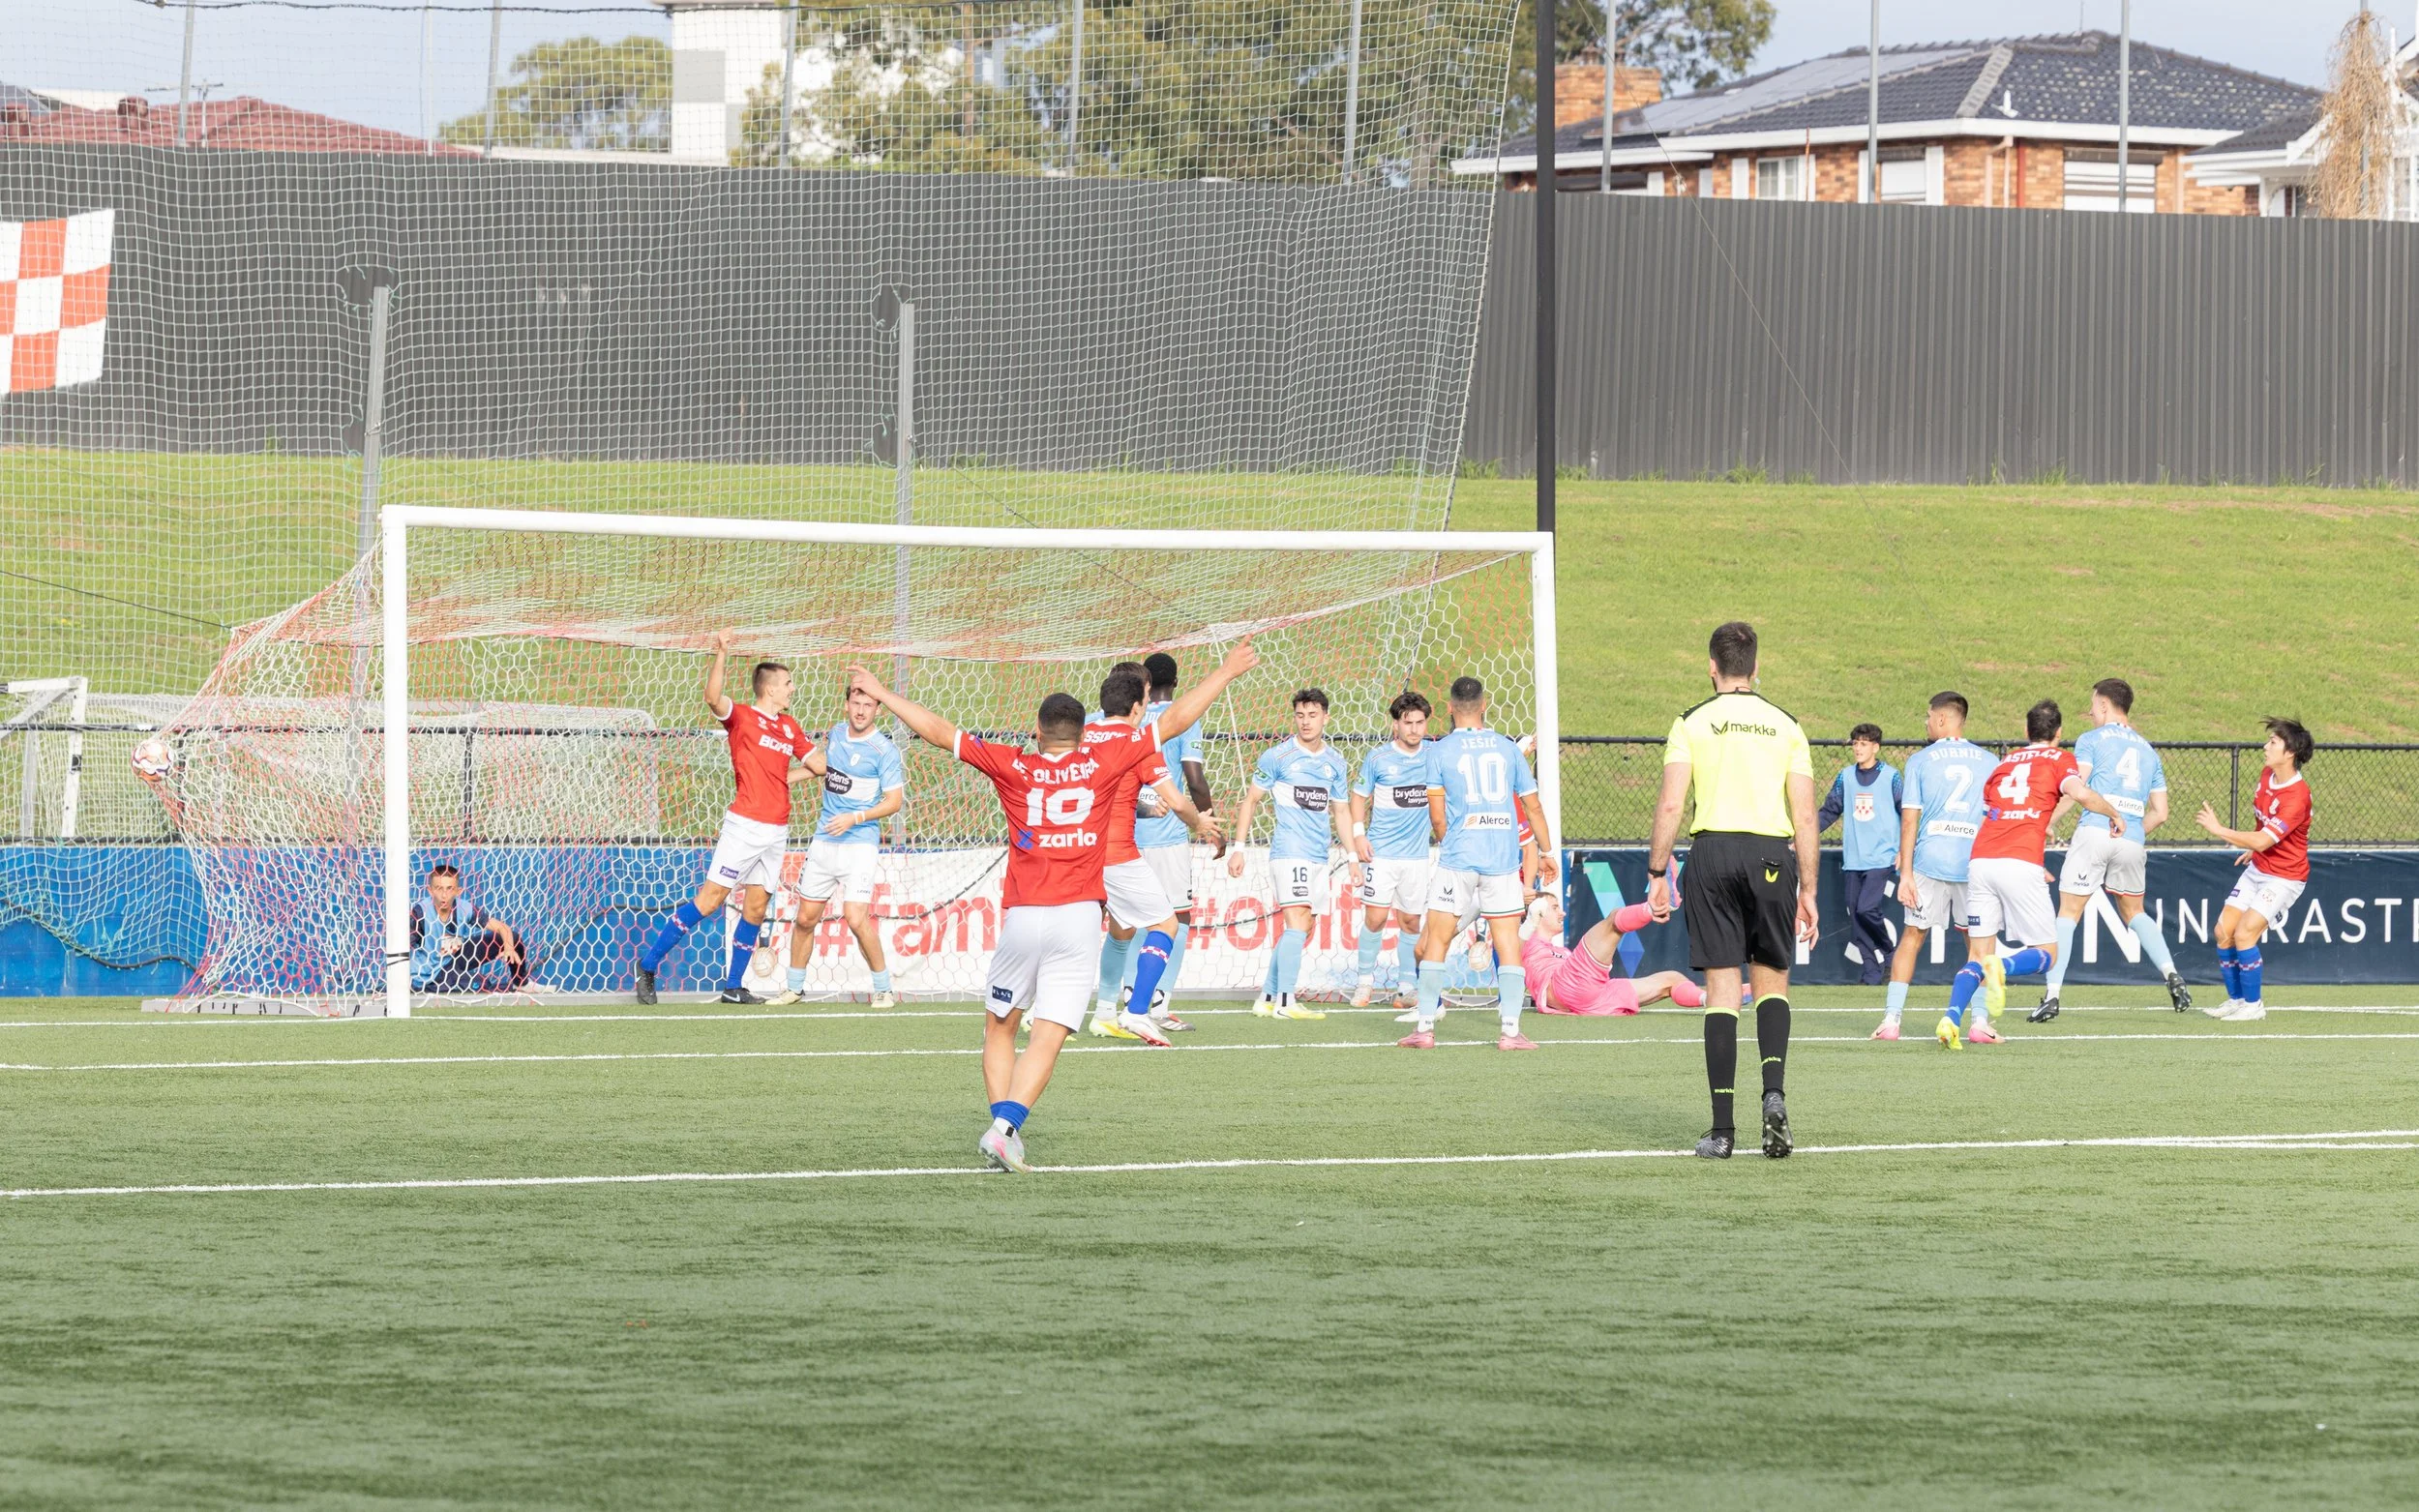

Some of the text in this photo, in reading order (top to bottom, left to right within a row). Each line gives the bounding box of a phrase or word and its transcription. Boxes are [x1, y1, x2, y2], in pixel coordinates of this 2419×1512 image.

[1730, 723, 1777, 737] markka
[825, 772, 851, 786] rydens
[1032, 757, 1100, 786] OLIVEIRA
[1456, 752, 1508, 806] 10
[2115, 746, 2140, 791] 4
[1296, 788, 1328, 802] brydens
[1944, 764, 1974, 814] 2
[1996, 762, 2032, 805] 4
[1026, 786, 1096, 827] 10
[1478, 815, 1510, 826] Alerce
[1944, 823, 1976, 836] Alerce
[1038, 827, 1098, 848] zarla
[1292, 866, 1308, 883] 16
[2155, 897, 2419, 944] INRAST
